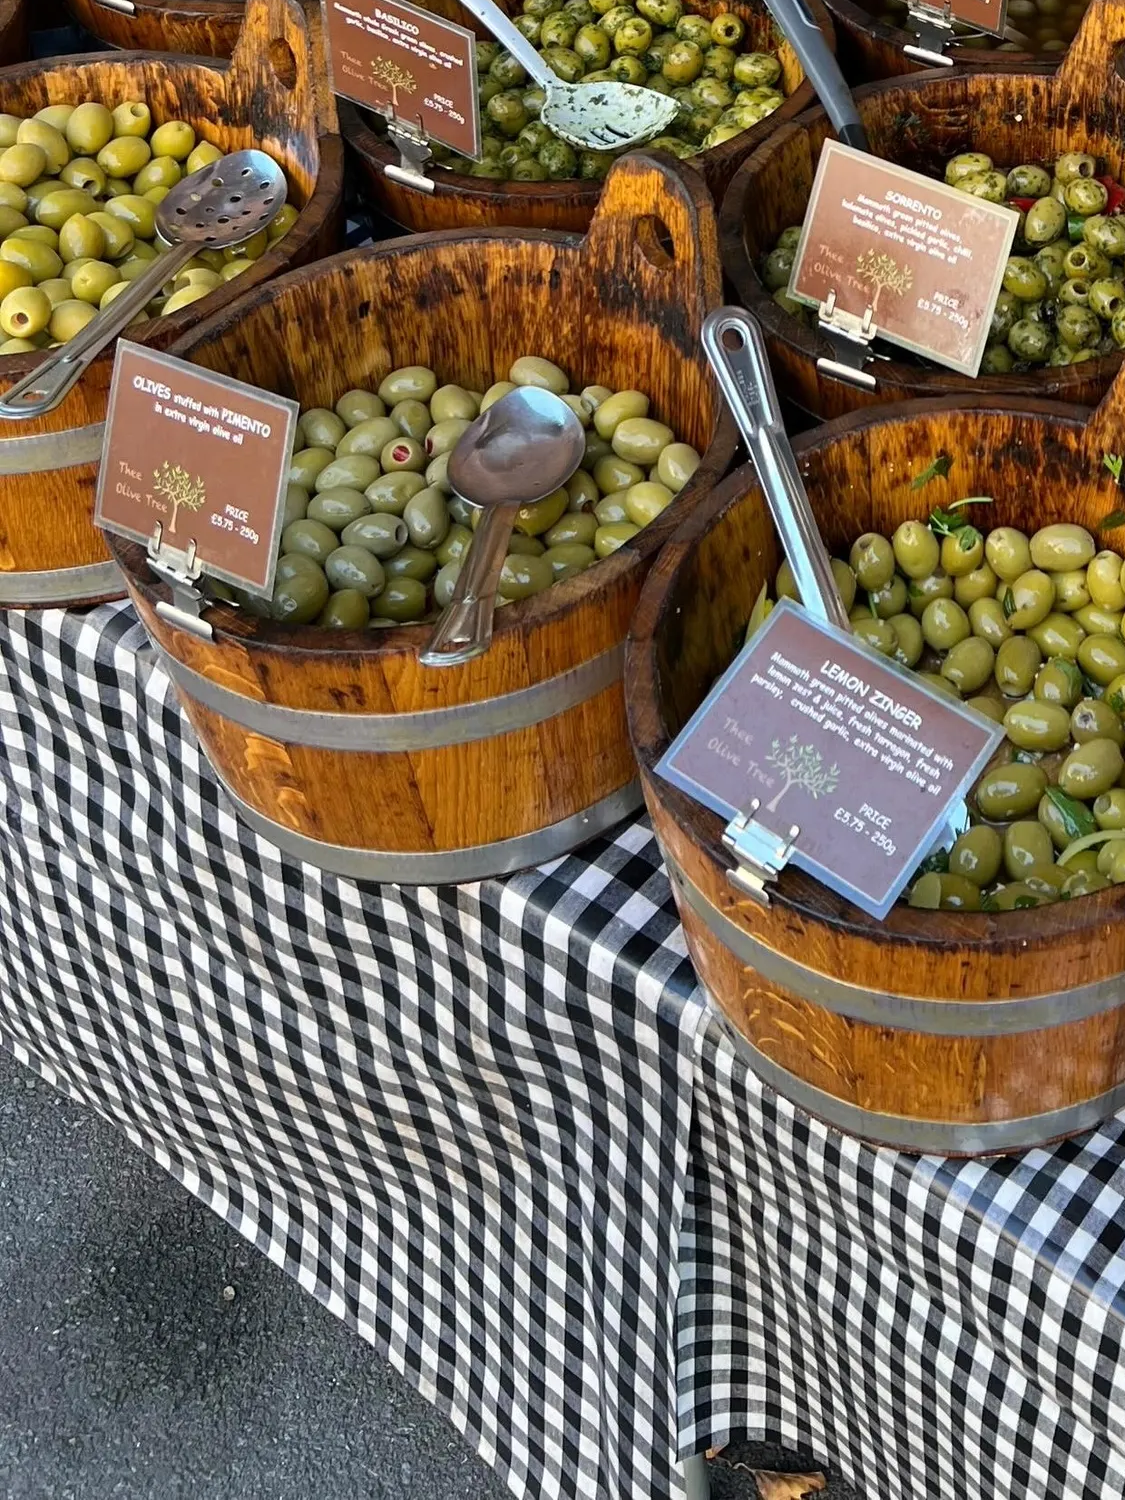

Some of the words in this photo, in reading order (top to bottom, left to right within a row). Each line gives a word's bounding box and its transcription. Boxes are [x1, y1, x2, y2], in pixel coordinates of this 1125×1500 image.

[375, 7, 419, 36] BASILICO
[885, 190, 942, 221] SORRENTO
[133, 375, 171, 400] OLIVES
[173, 394, 202, 412] stuffed
[203, 405, 219, 419] with
[221, 408, 271, 438] PIMENTO
[154, 401, 162, 414] in
[164, 407, 186, 423] extra
[188, 415, 210, 434] virgin
[212, 424, 231, 440] olive
[232, 432, 244, 445] oil
[211, 513, 233, 531] £5.75
[240, 525, 259, 545] 250g
[225, 504, 249, 523] PRICE
[770, 651, 811, 682] Mammoth
[808, 677, 836, 698] green
[834, 692, 865, 715] pitted
[863, 710, 890, 730] olives
[888, 725, 934, 758] marinated
[933, 753, 954, 771] with
[819, 659, 870, 697] LEMON
[868, 690, 923, 731] ZINGER
[766, 664, 793, 686] lemon
[791, 681, 813, 698] zest
[811, 693, 822, 704] &
[847, 715, 873, 736] fresh
[915, 757, 941, 779] fresh
[789, 697, 826, 723] crushed
[853, 737, 880, 757] extra
[879, 753, 906, 775] virgin
[905, 769, 927, 787] olive
[927, 783, 942, 796] oil
[833, 806, 865, 833] £5.75
[870, 830, 897, 857] 250g
[858, 803, 892, 830] PRICE
